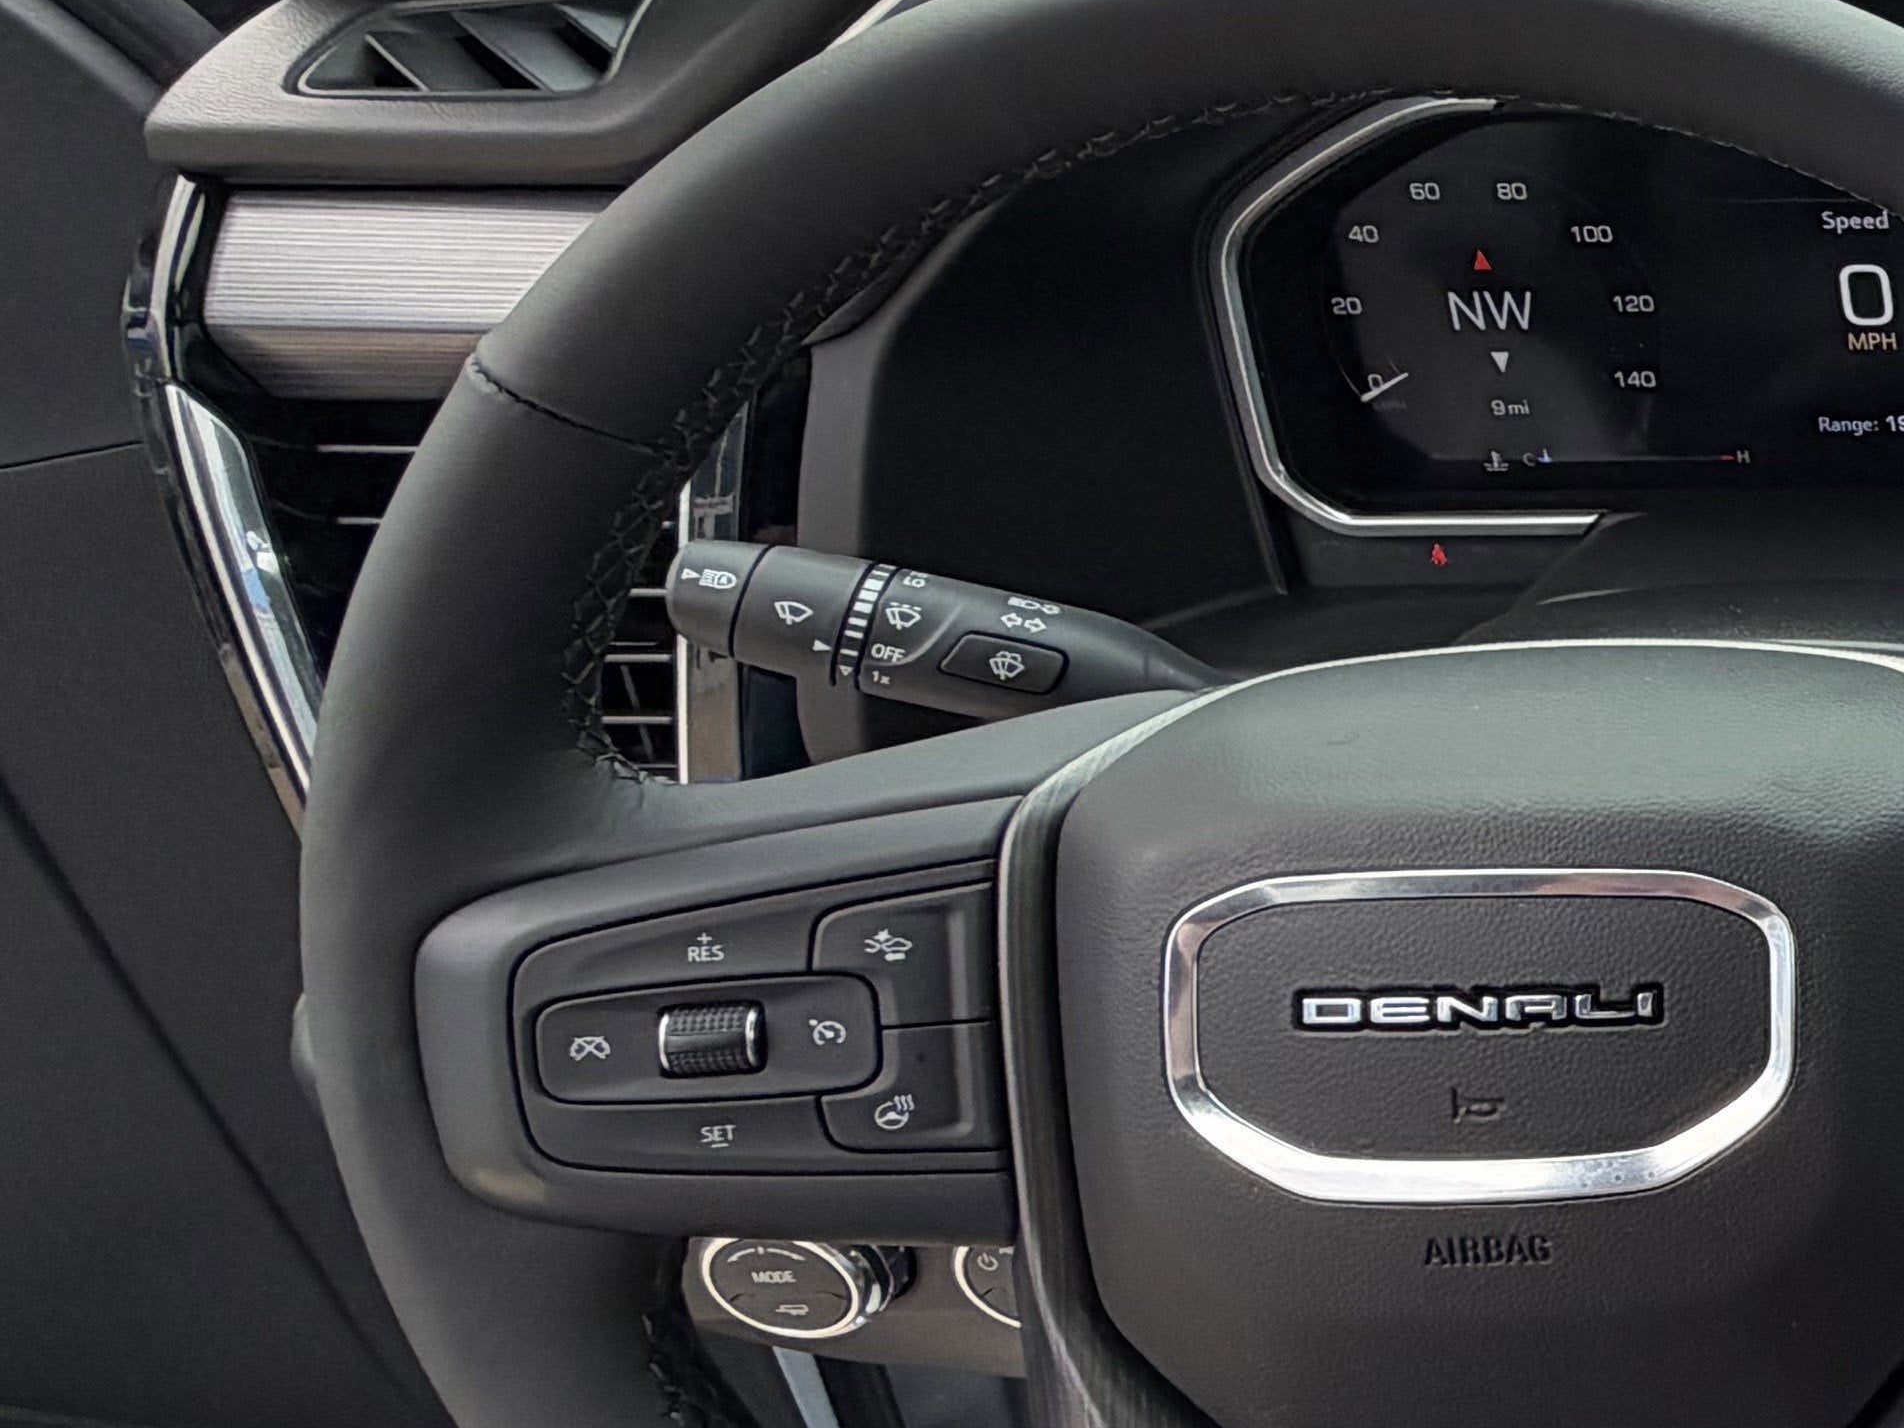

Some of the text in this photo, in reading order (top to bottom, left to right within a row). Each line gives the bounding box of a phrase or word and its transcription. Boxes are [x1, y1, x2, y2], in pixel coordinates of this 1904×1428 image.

[1410, 182, 1441, 201] 60
[1496, 182, 1527, 201] 80
[1822, 210, 1890, 233] Speed
[1348, 225, 1379, 243] 40
[1571, 225, 1613, 243] 100
[1838, 263, 1895, 326] 0
[1331, 296, 1362, 315] 20
[1447, 290, 1532, 331] NW
[1613, 295, 1655, 314] 120
[1847, 331, 1898, 352] MPH
[1615, 370, 1657, 389] 140
[1491, 399, 1530, 416] 9 mi
[1818, 415, 1878, 434] Range:
[1737, 450, 1750, 465] H
[870, 643, 906, 663] OFF
[687, 944, 725, 962] RES
[1298, 989, 1657, 1025] DENALI
[700, 1124, 737, 1144] SET
[1423, 1232, 1553, 1268] AIRBAG
[750, 1269, 797, 1285] MODE
